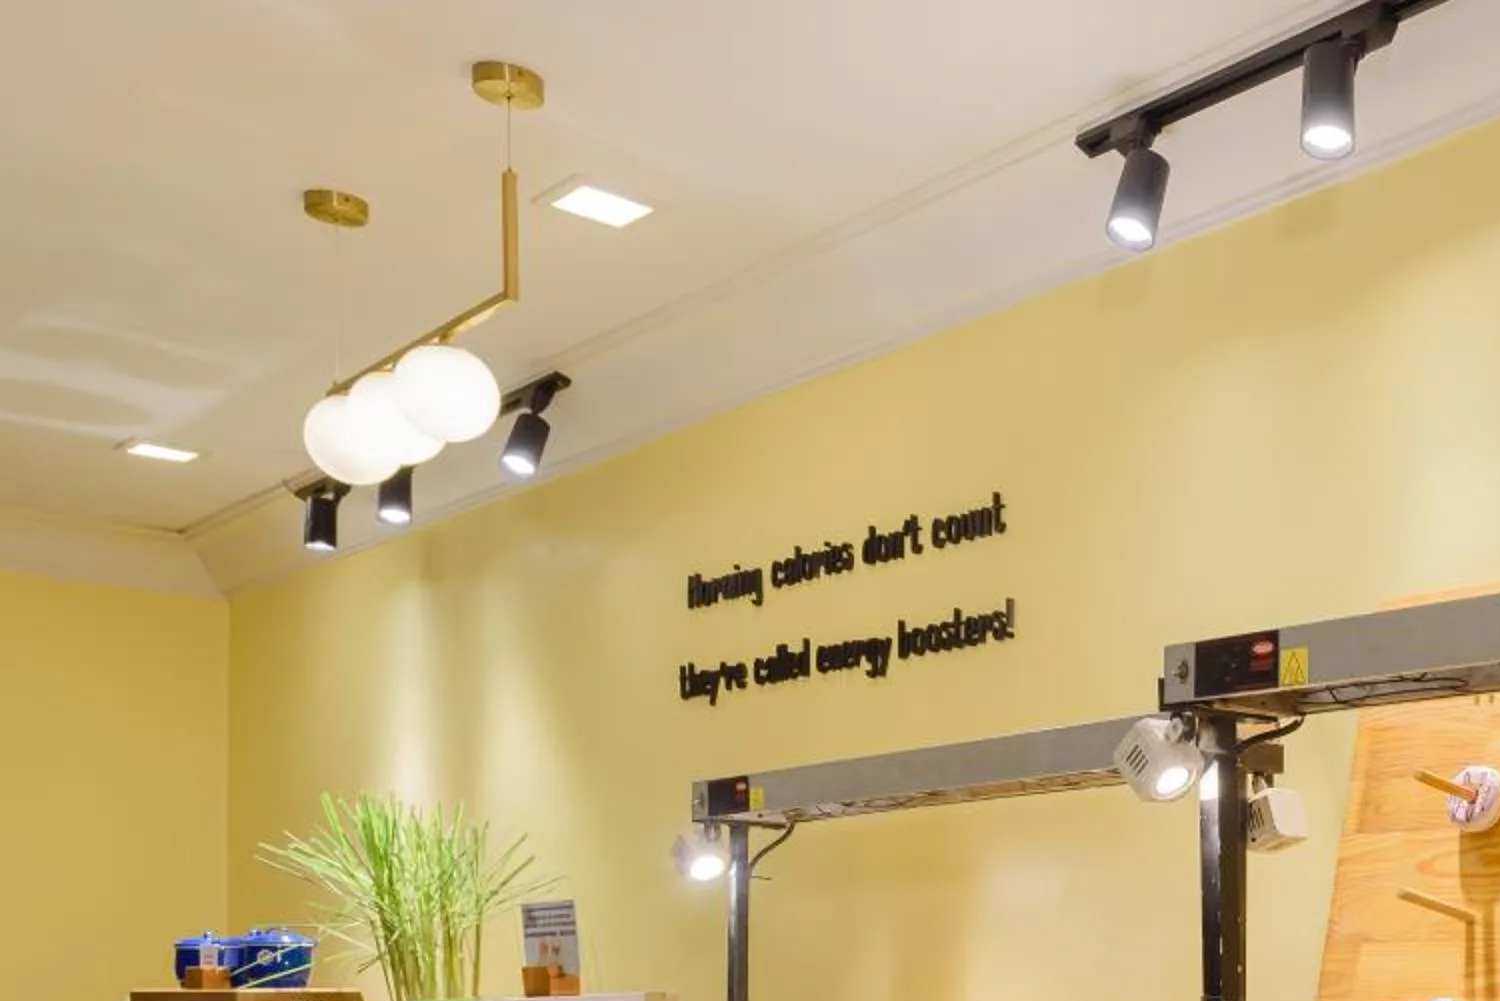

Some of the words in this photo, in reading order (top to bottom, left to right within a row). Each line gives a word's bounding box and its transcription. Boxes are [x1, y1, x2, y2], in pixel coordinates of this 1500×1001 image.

[771, 540, 855, 588] calories
[862, 514, 924, 565] don't
[931, 491, 1007, 549] count
[679, 661, 748, 706] they're
[816, 636, 892, 679] energy
[897, 597, 1015, 660] boosters!
